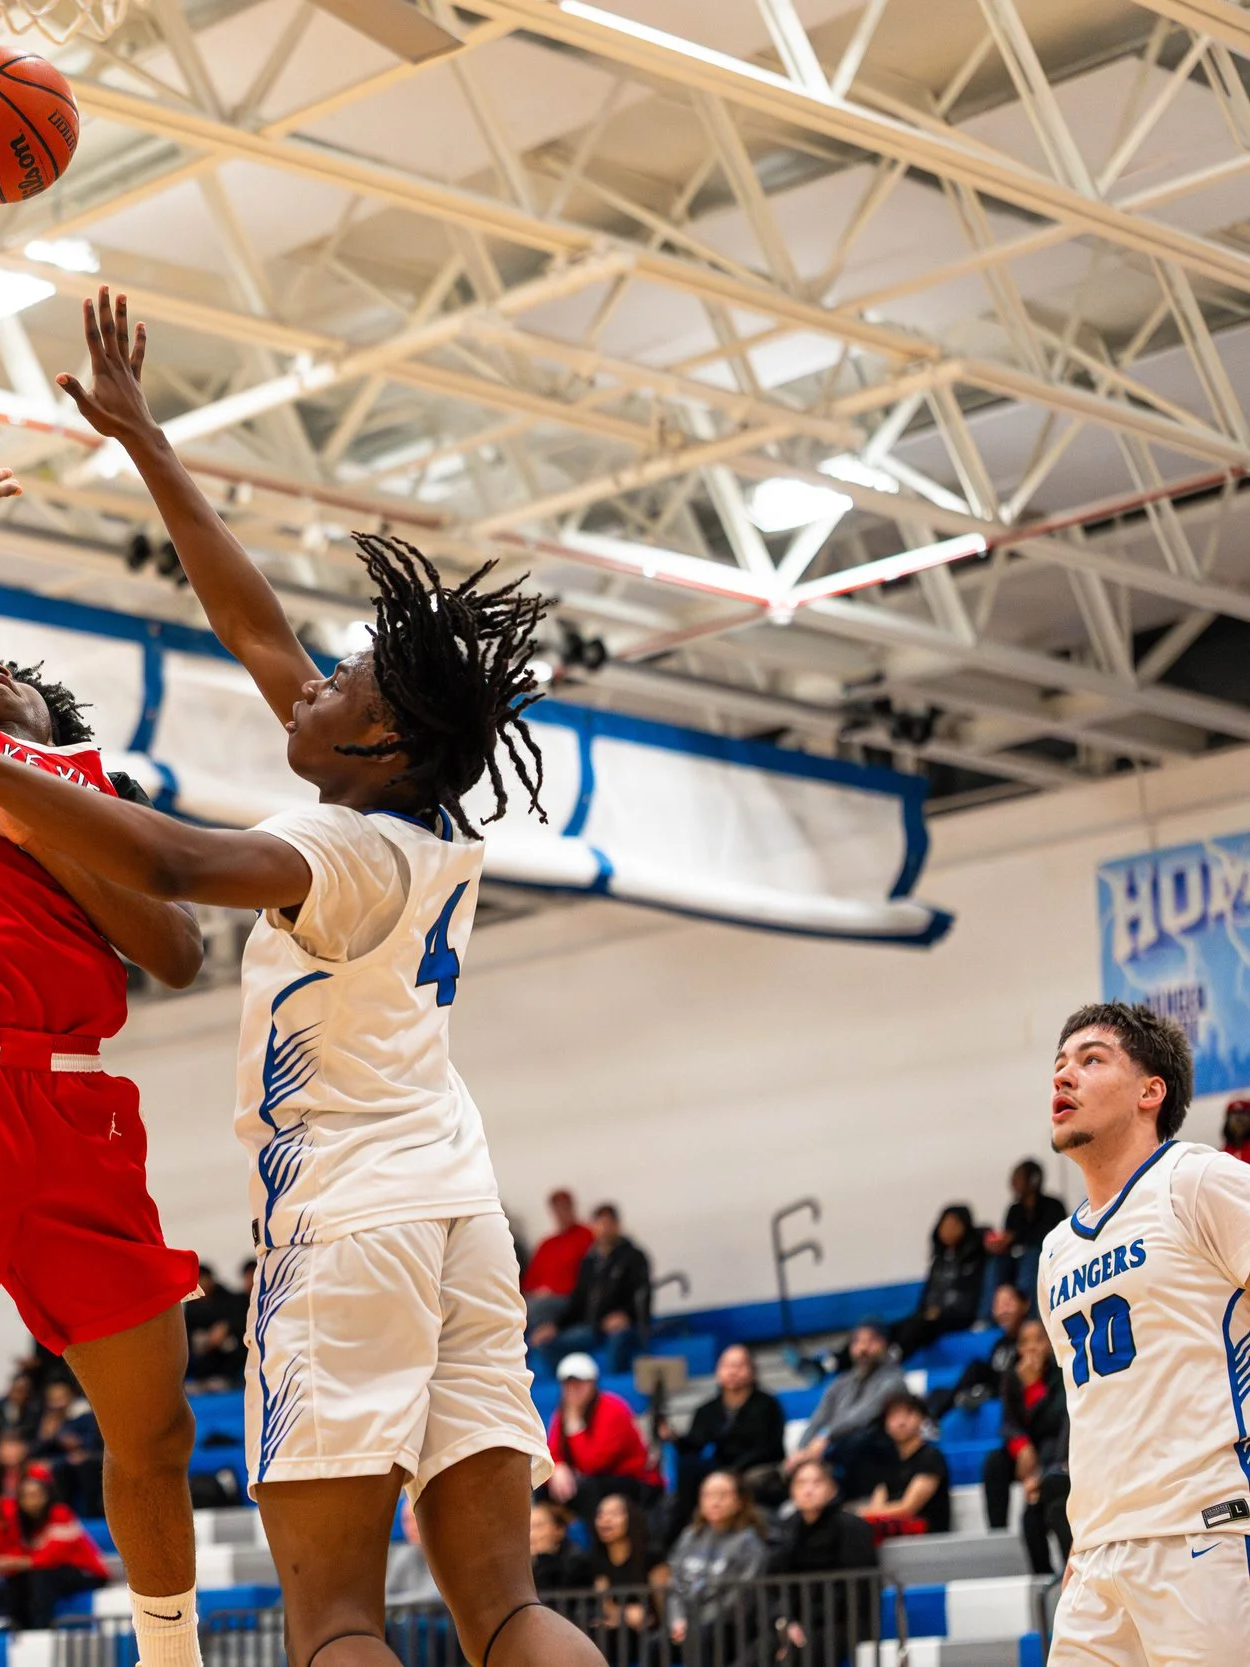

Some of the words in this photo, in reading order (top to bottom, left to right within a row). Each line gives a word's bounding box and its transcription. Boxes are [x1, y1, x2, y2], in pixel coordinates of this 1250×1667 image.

[10, 131, 46, 200] ilson
[415, 880, 470, 1007] 4
[1062, 1293, 1137, 1388] 10
